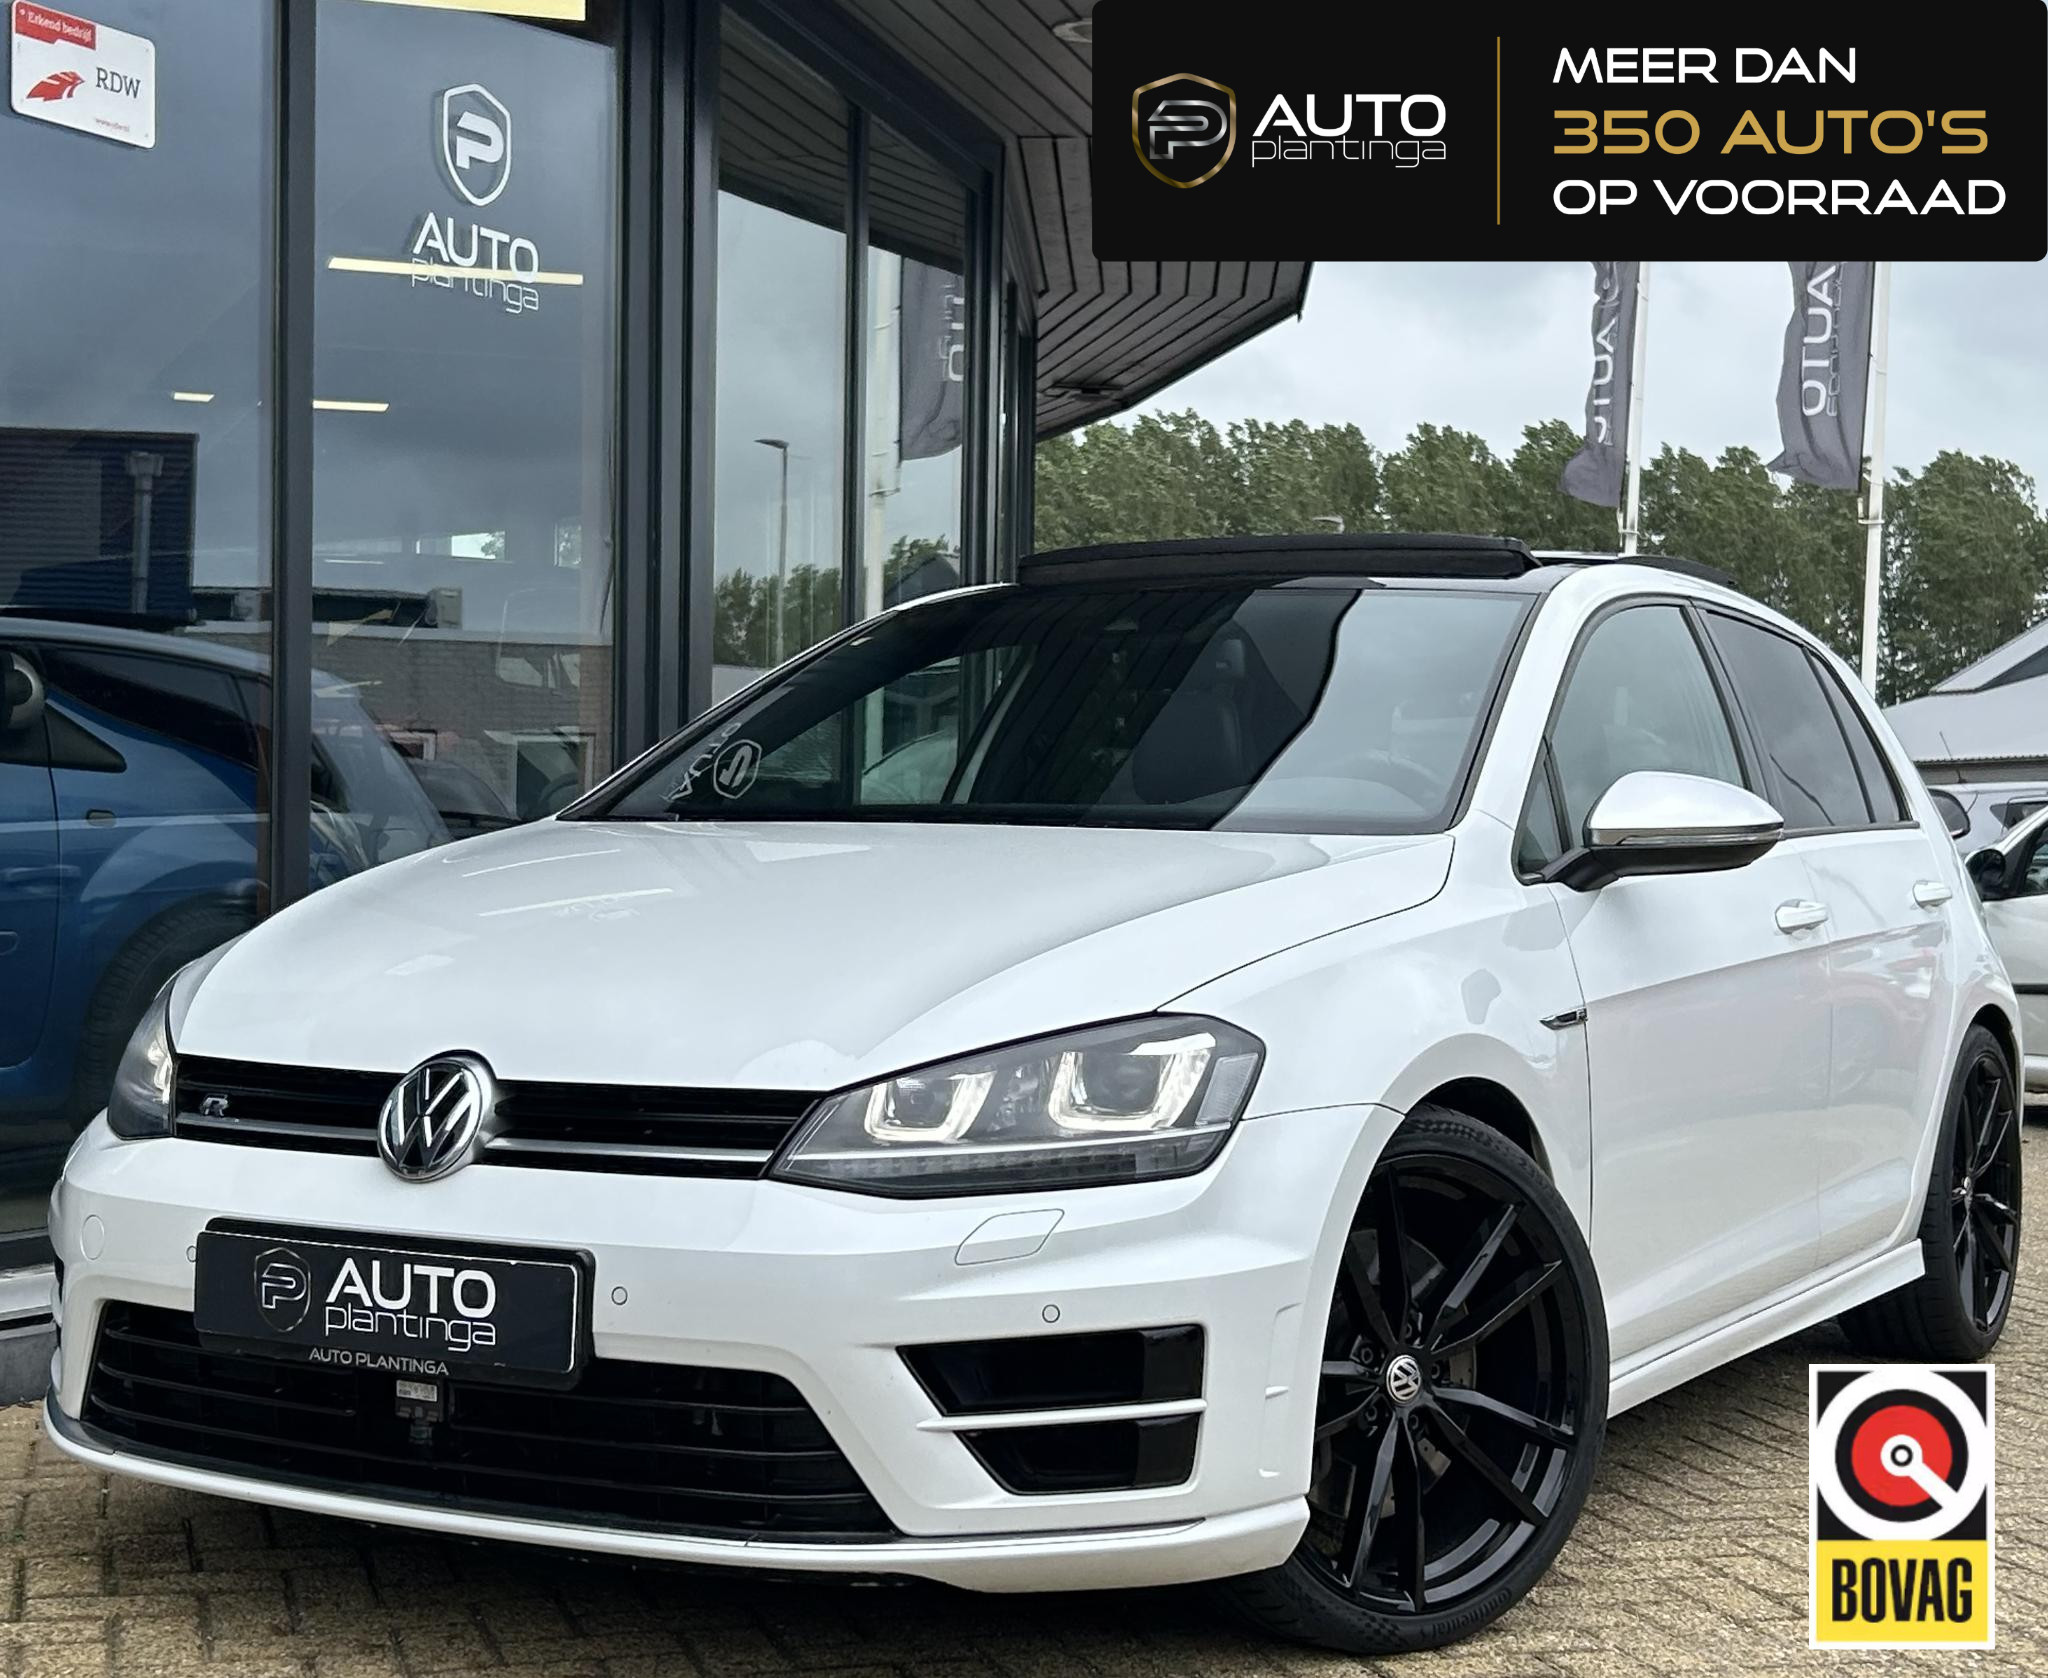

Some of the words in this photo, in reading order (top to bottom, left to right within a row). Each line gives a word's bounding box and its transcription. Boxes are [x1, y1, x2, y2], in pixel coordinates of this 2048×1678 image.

[96, 66, 141, 99] RDW
[411, 211, 539, 284] AUTO
[411, 256, 539, 314] plantinga
[324, 1257, 497, 1318] AUTO
[324, 1306, 497, 1352] plantinga
[309, 1347, 353, 1365] AUTO
[355, 1352, 449, 1376] PLANTINGA
